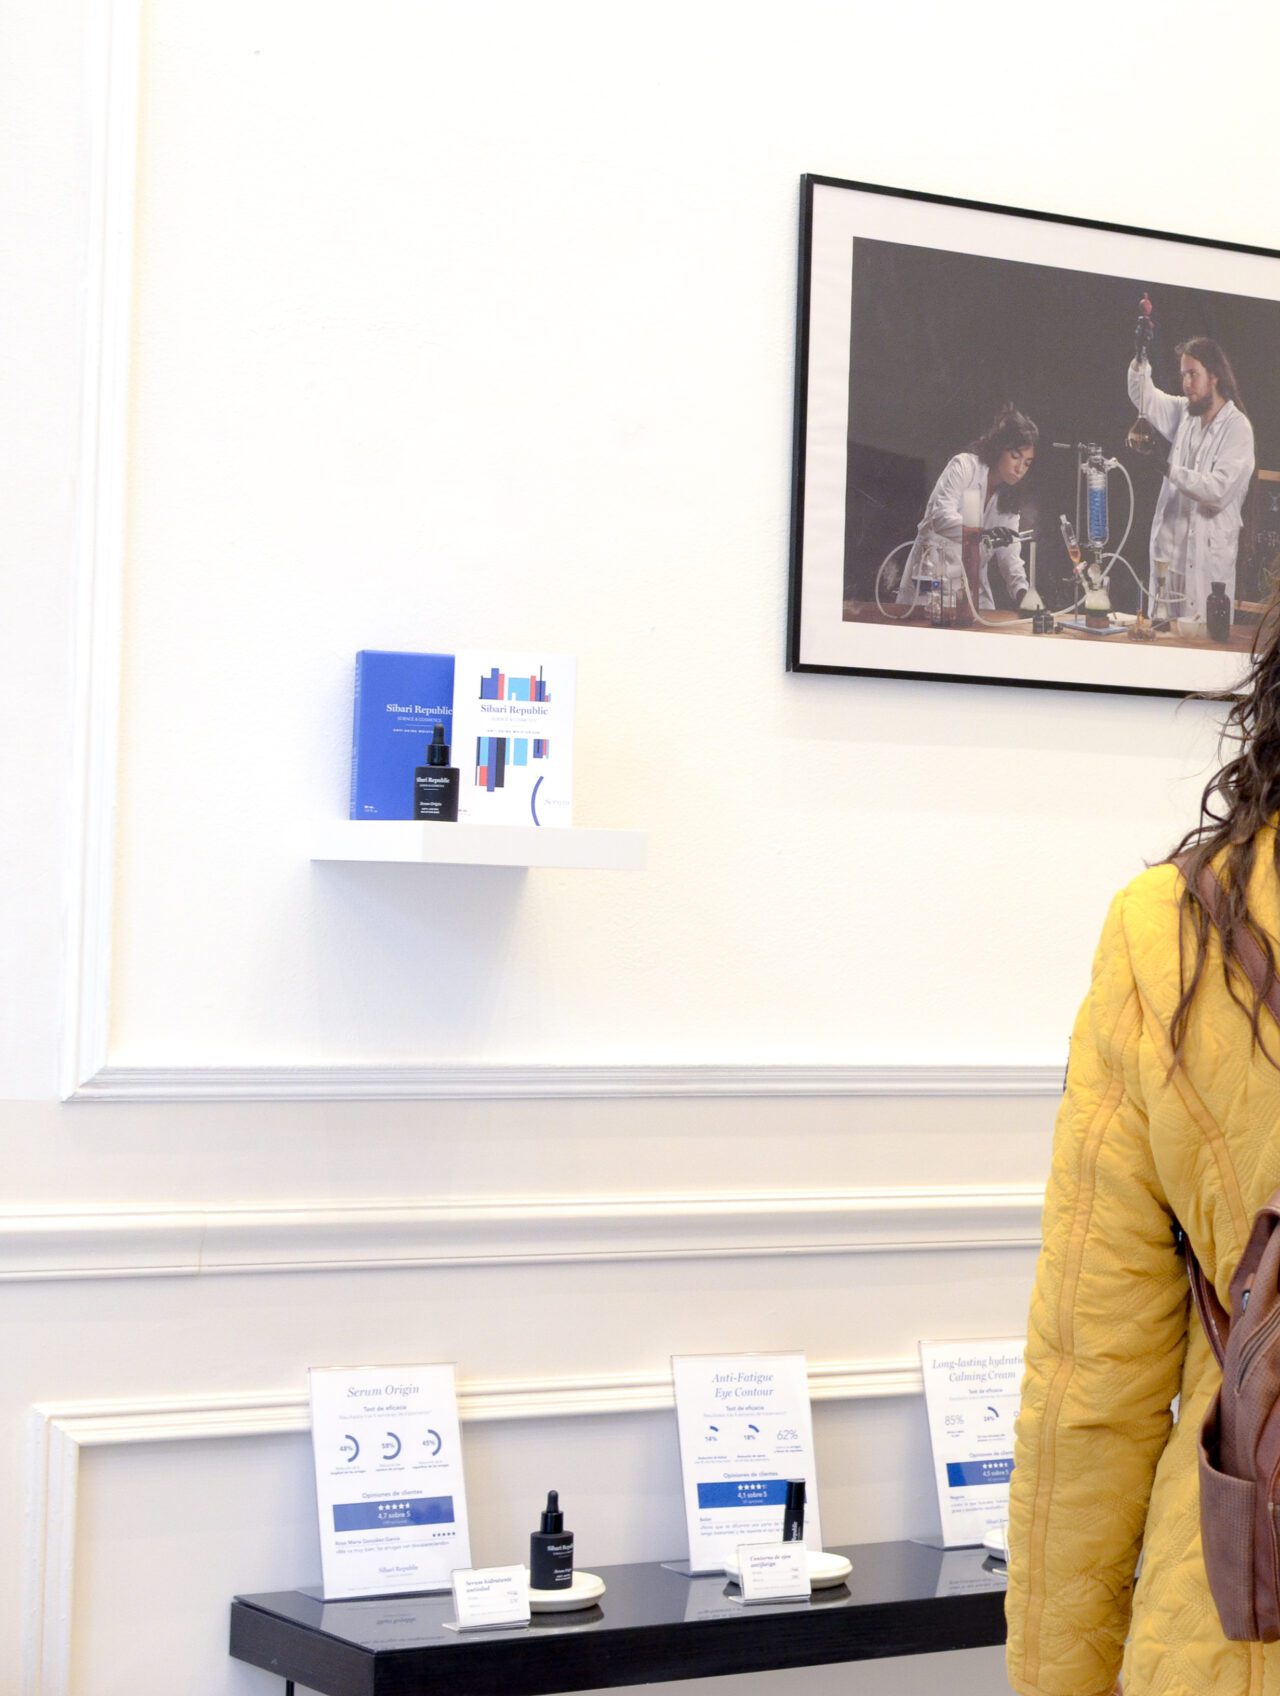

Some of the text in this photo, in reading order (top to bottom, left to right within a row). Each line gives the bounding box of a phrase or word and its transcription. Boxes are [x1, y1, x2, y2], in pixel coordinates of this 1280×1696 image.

[386, 703, 453, 716] Sibari Republic
[481, 704, 548, 716] Sibari Republic
[711, 1372, 774, 1385] Anti-Fatigue
[949, 1370, 1016, 1382] Calming Cream
[346, 1384, 420, 1398] Serum Origin
[715, 1387, 774, 1400] Eye Contour
[944, 1414, 965, 1426] 85%
[776, 1428, 799, 1441] 62%
[747, 1490, 763, 1498] sobre
[388, 1511, 405, 1519] sobre
[406, 1510, 411, 1518] 5
